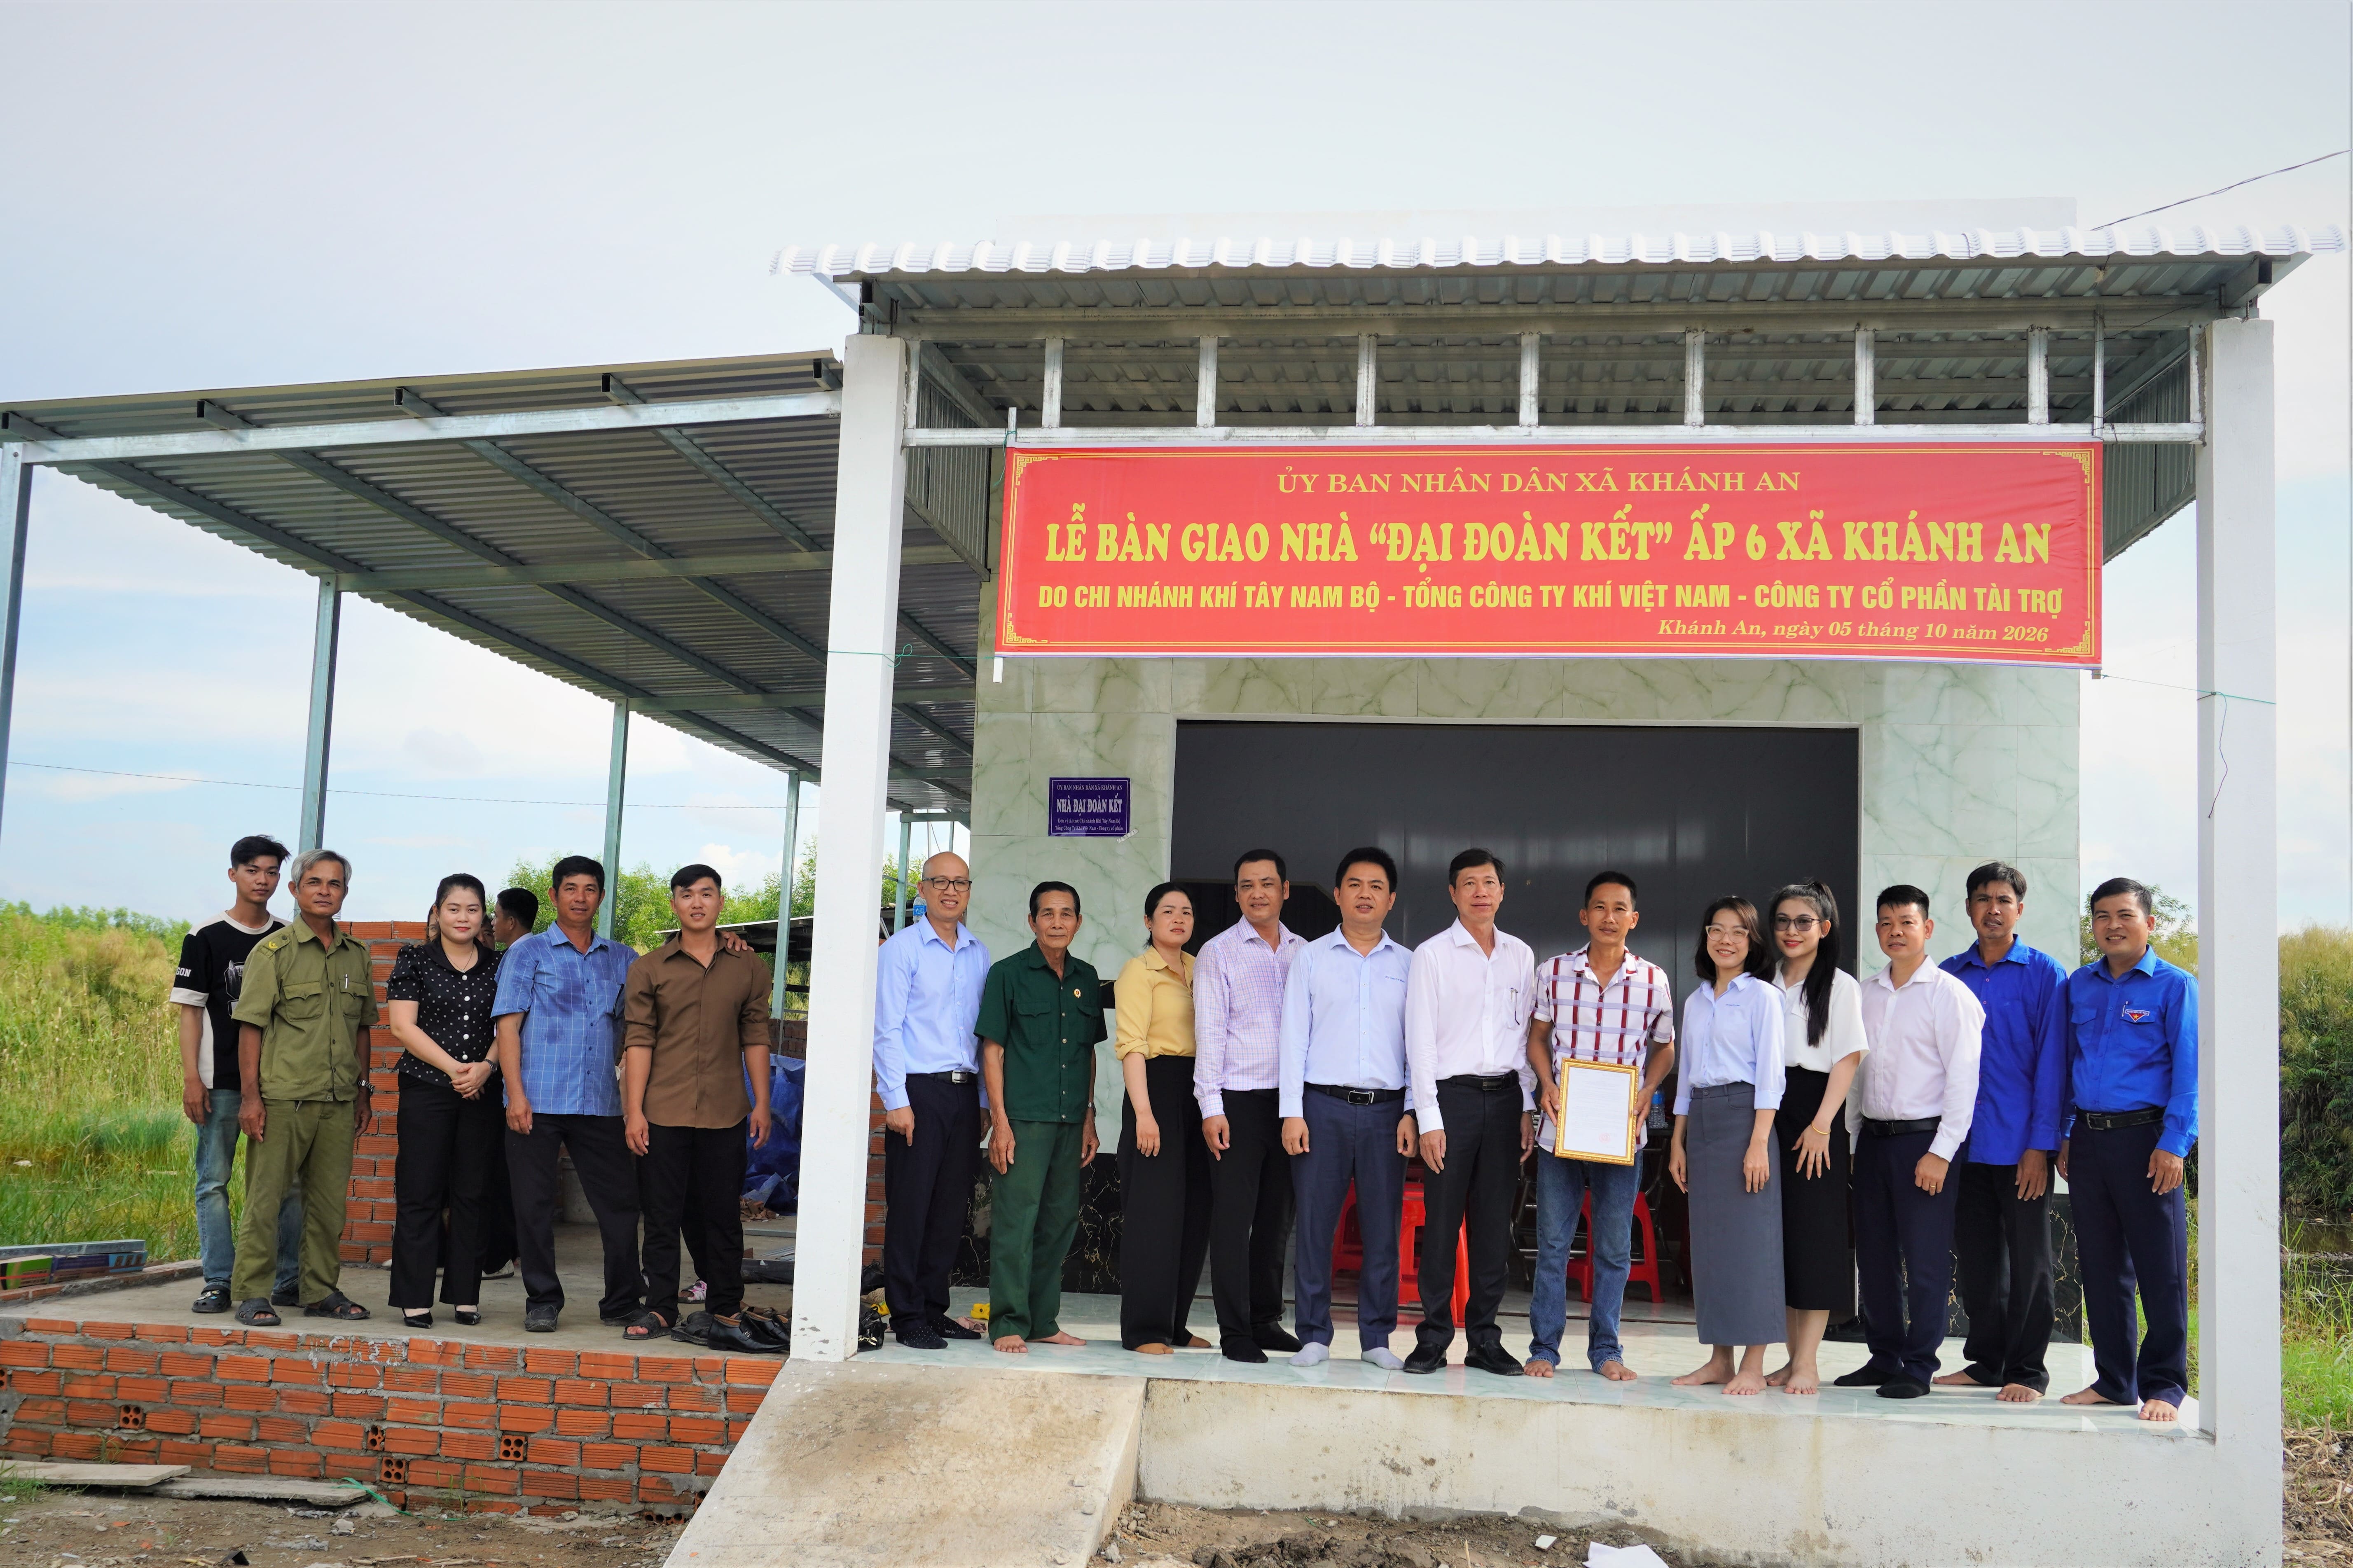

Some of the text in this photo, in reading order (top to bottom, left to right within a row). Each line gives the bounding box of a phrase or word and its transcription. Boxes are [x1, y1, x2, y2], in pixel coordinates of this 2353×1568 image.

[1278, 466, 1800, 493] ỦY BAN NHÂN DÂN XÃ KHÁNH AN
[1045, 502, 2051, 573] LỄ BÀN GIAO NHÀ “ĐẠI ĐOÀN KẾT” ẤP 6 XÃ KHÁNH AN
[1039, 585, 1067, 608] DO
[1074, 585, 1110, 608] CHI
[1117, 581, 1193, 608] NHÁNH
[1200, 581, 1237, 608] KHÍ
[1244, 581, 1284, 608] TÂY
[1290, 586, 1343, 608] NAM
[1350, 581, 1380, 613] BỘ
[1403, 577, 1462, 608] TỔNG
[1469, 580, 1532, 608] CÔNG
[1539, 585, 1566, 608] TY
[1573, 580, 1612, 608] KHÍ
[1619, 580, 1668, 612] VIỆT
[1675, 584, 1730, 607] NAM
[1754, 580, 1820, 608] CÔNG
[1827, 585, 1854, 608] TY
[1862, 577, 1895, 609] CỔ
[1902, 579, 1967, 610] PHẦN
[1974, 583, 2011, 612] TÀI
[2017, 588, 2063, 619] TRỢ
[1658, 620, 2049, 642] Khánh An, ngày 05 tháng 10 năm 2026
[1056, 793, 1123, 816] NHÀ ĐẠI ĐOÀN KẾT
